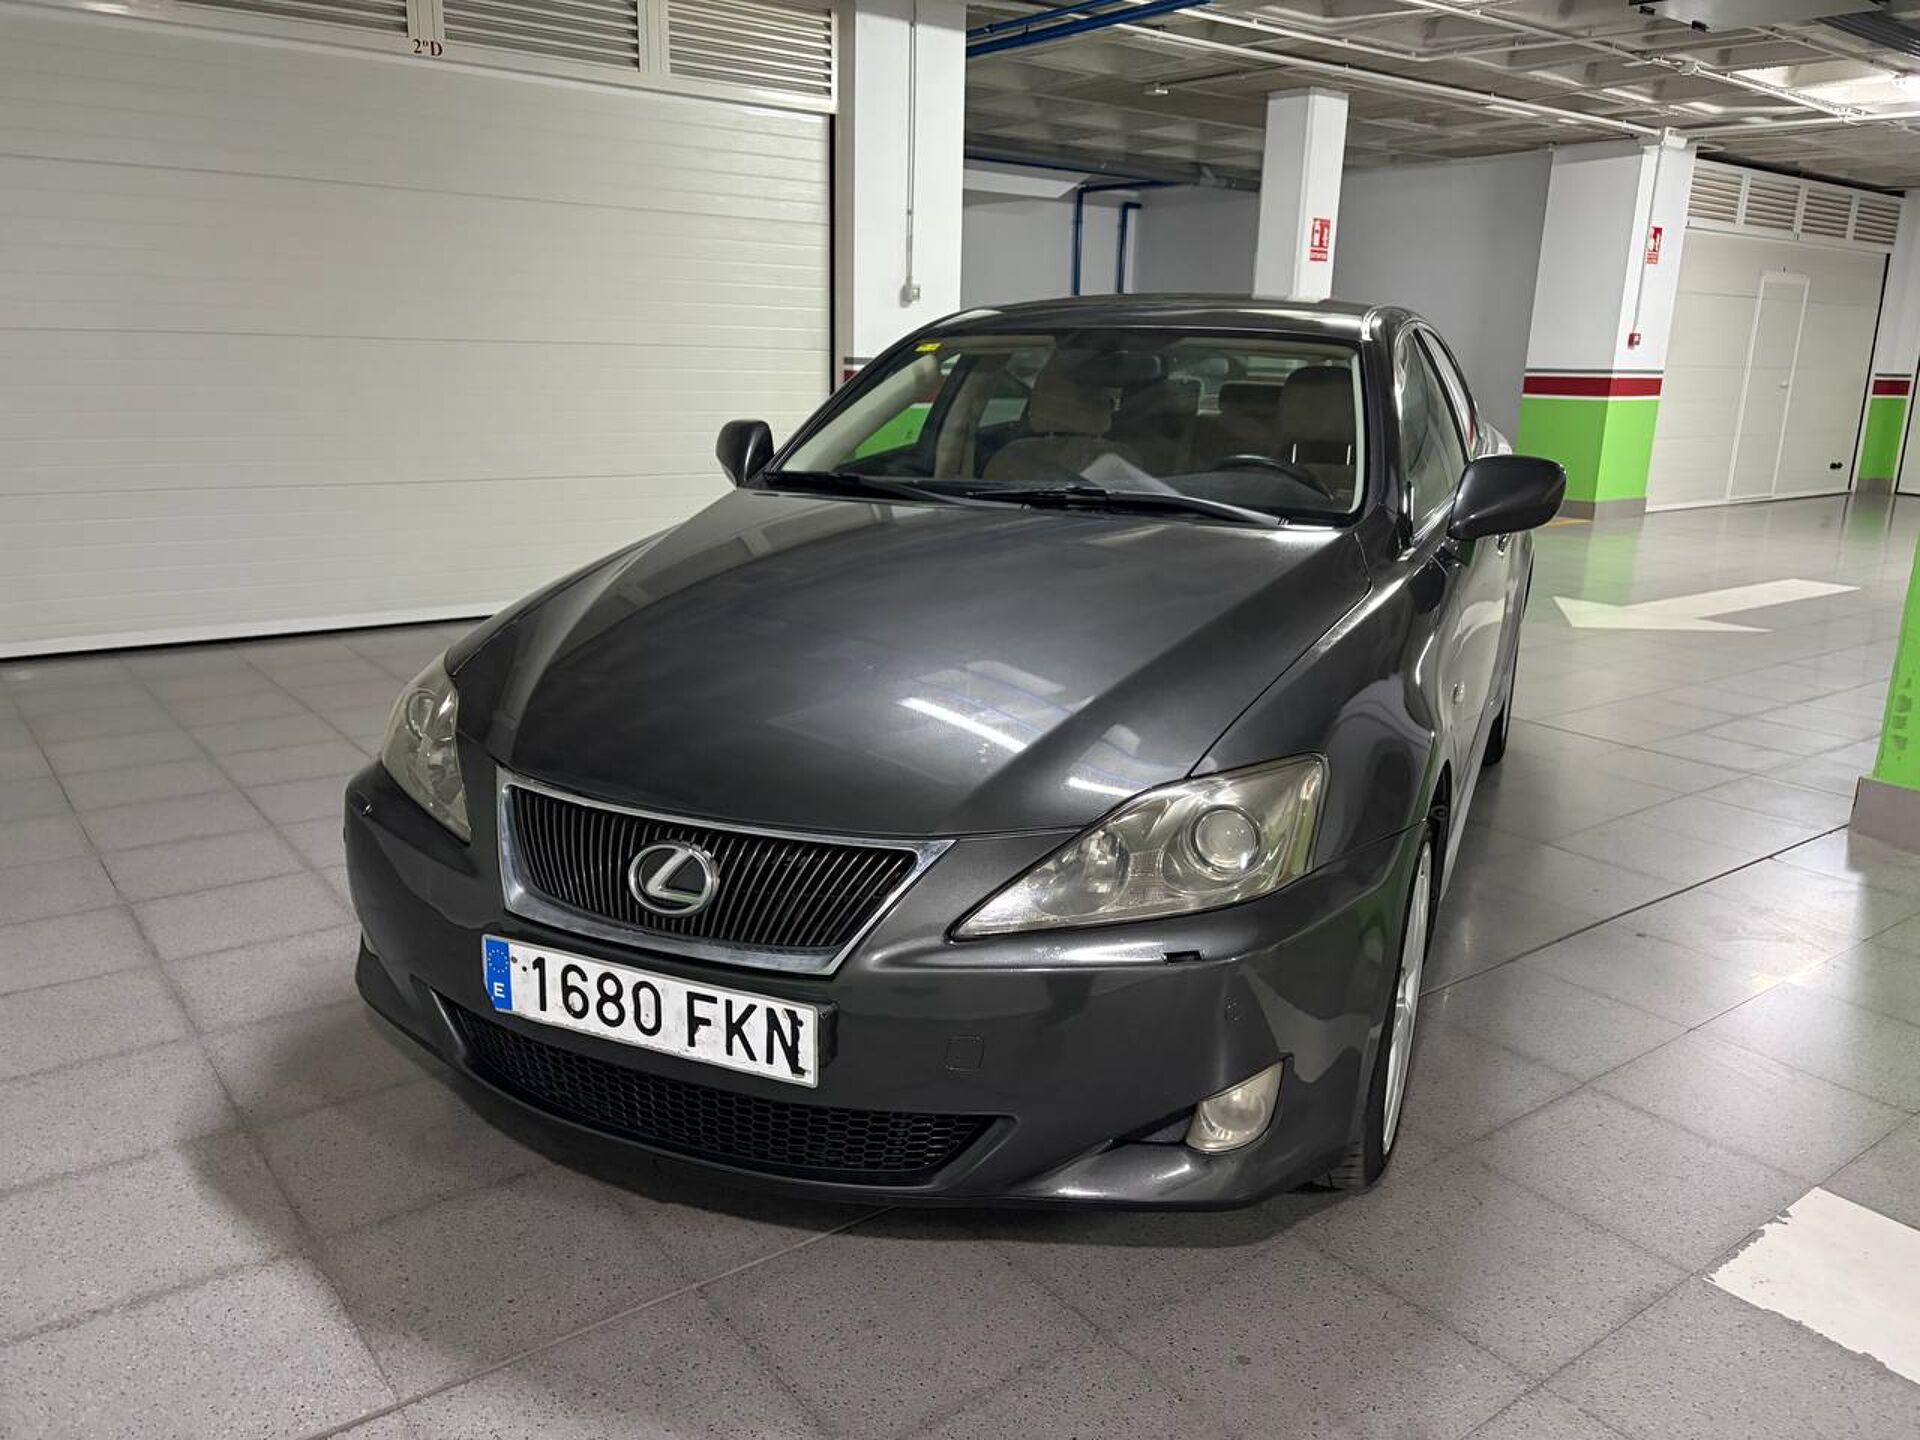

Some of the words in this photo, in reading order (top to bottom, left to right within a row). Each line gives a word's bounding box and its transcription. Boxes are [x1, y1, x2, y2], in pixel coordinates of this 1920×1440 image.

[493, 982, 505, 998] E
[532, 956, 662, 1036] 1680
[686, 991, 806, 1075] FKN
